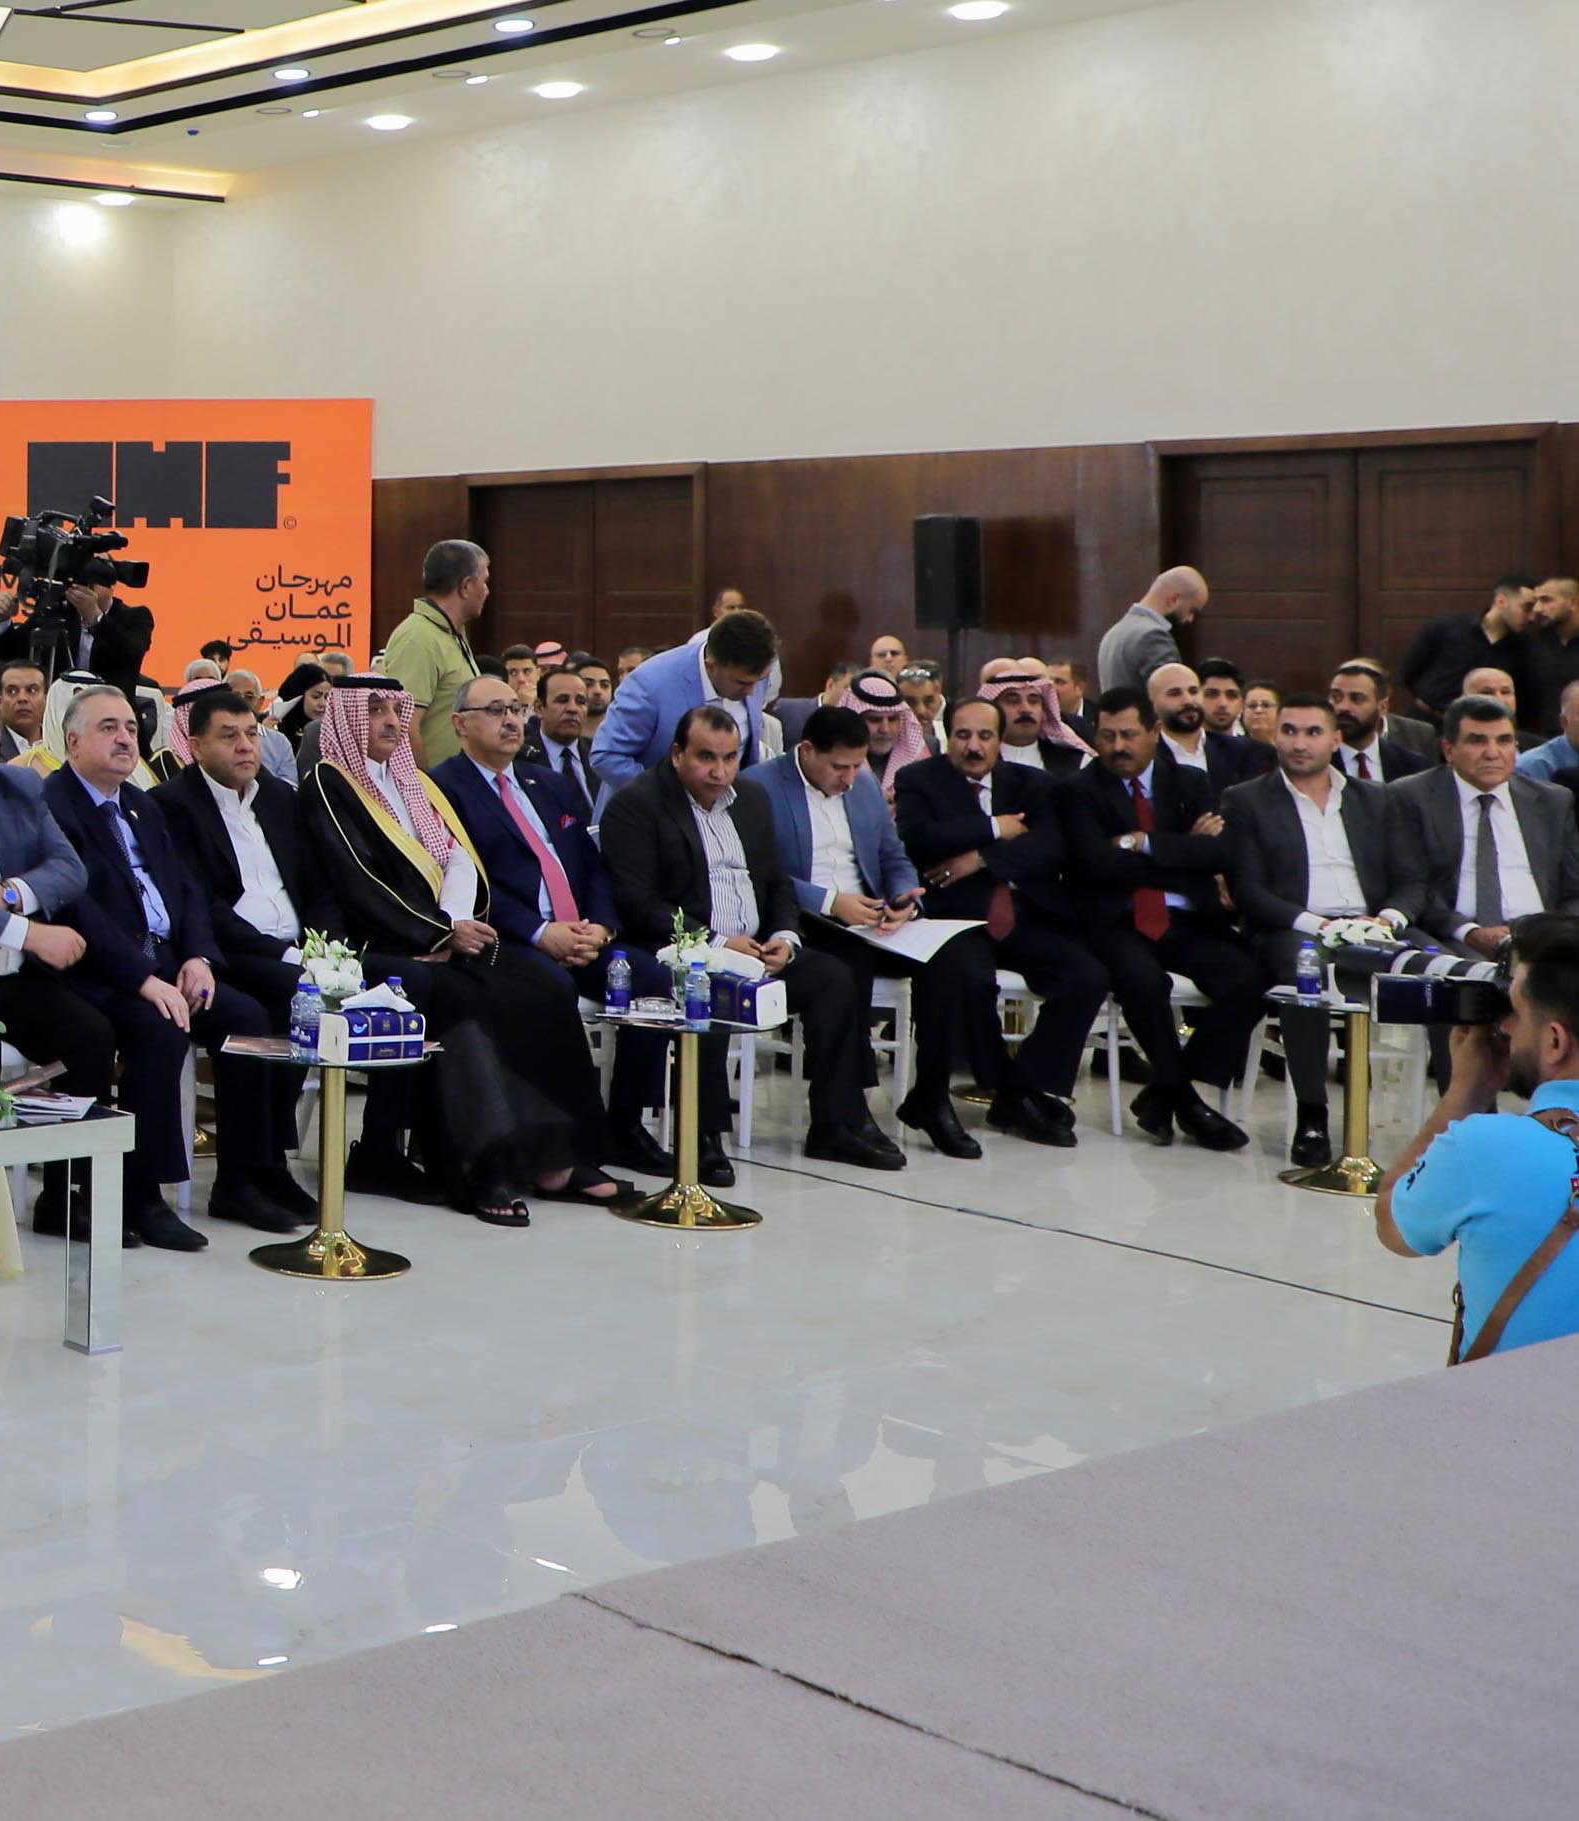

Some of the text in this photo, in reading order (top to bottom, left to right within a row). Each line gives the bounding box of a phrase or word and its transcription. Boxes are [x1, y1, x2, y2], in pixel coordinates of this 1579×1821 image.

[256, 564, 352, 597] مهرجان
[265, 594, 352, 621] عمان
[227, 621, 352, 653] الموسيقى
